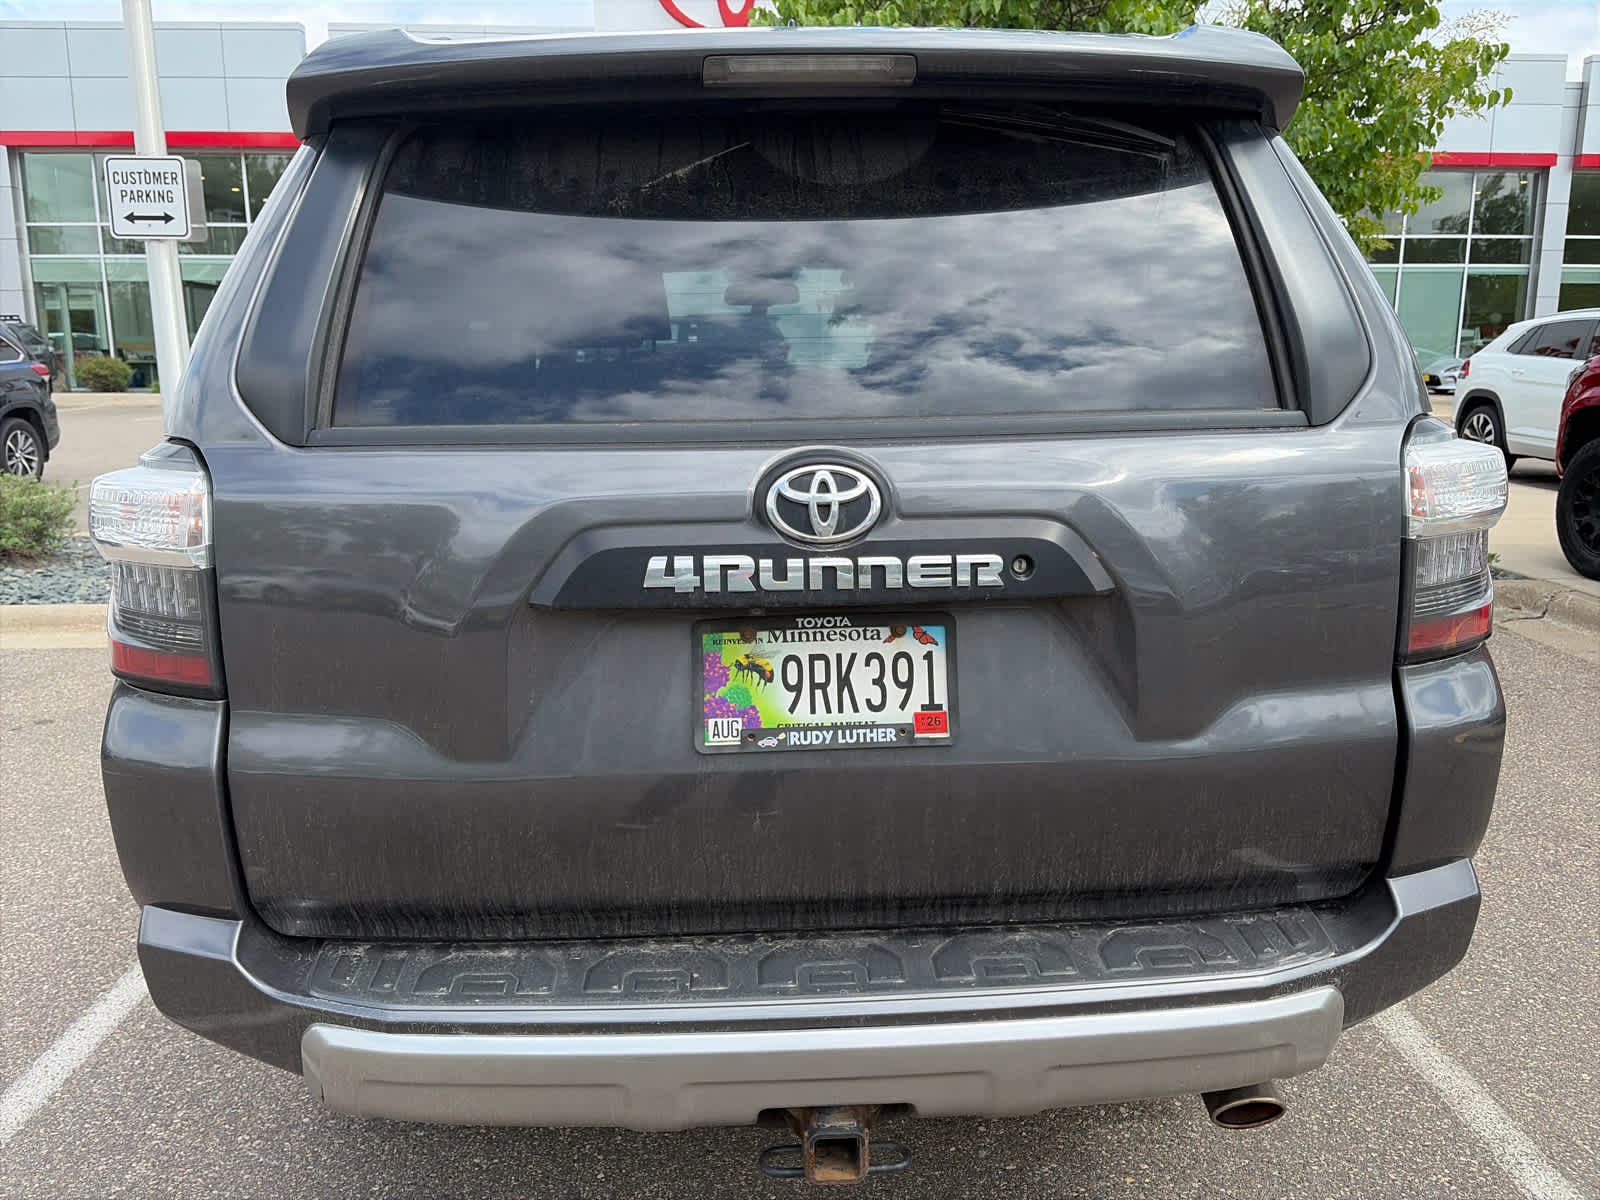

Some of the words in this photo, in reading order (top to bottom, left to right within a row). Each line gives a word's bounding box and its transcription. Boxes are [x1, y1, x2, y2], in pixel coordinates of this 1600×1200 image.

[112, 171, 178, 185] CUSTOMER
[120, 189, 174, 203] PARKING
[795, 616, 852, 628] TOYOTA
[767, 626, 882, 644] Minnesota
[781, 650, 944, 716] 9RK391
[712, 719, 739, 739] AUG
[790, 729, 833, 746] RUDY
[838, 727, 897, 743] LUTHER
